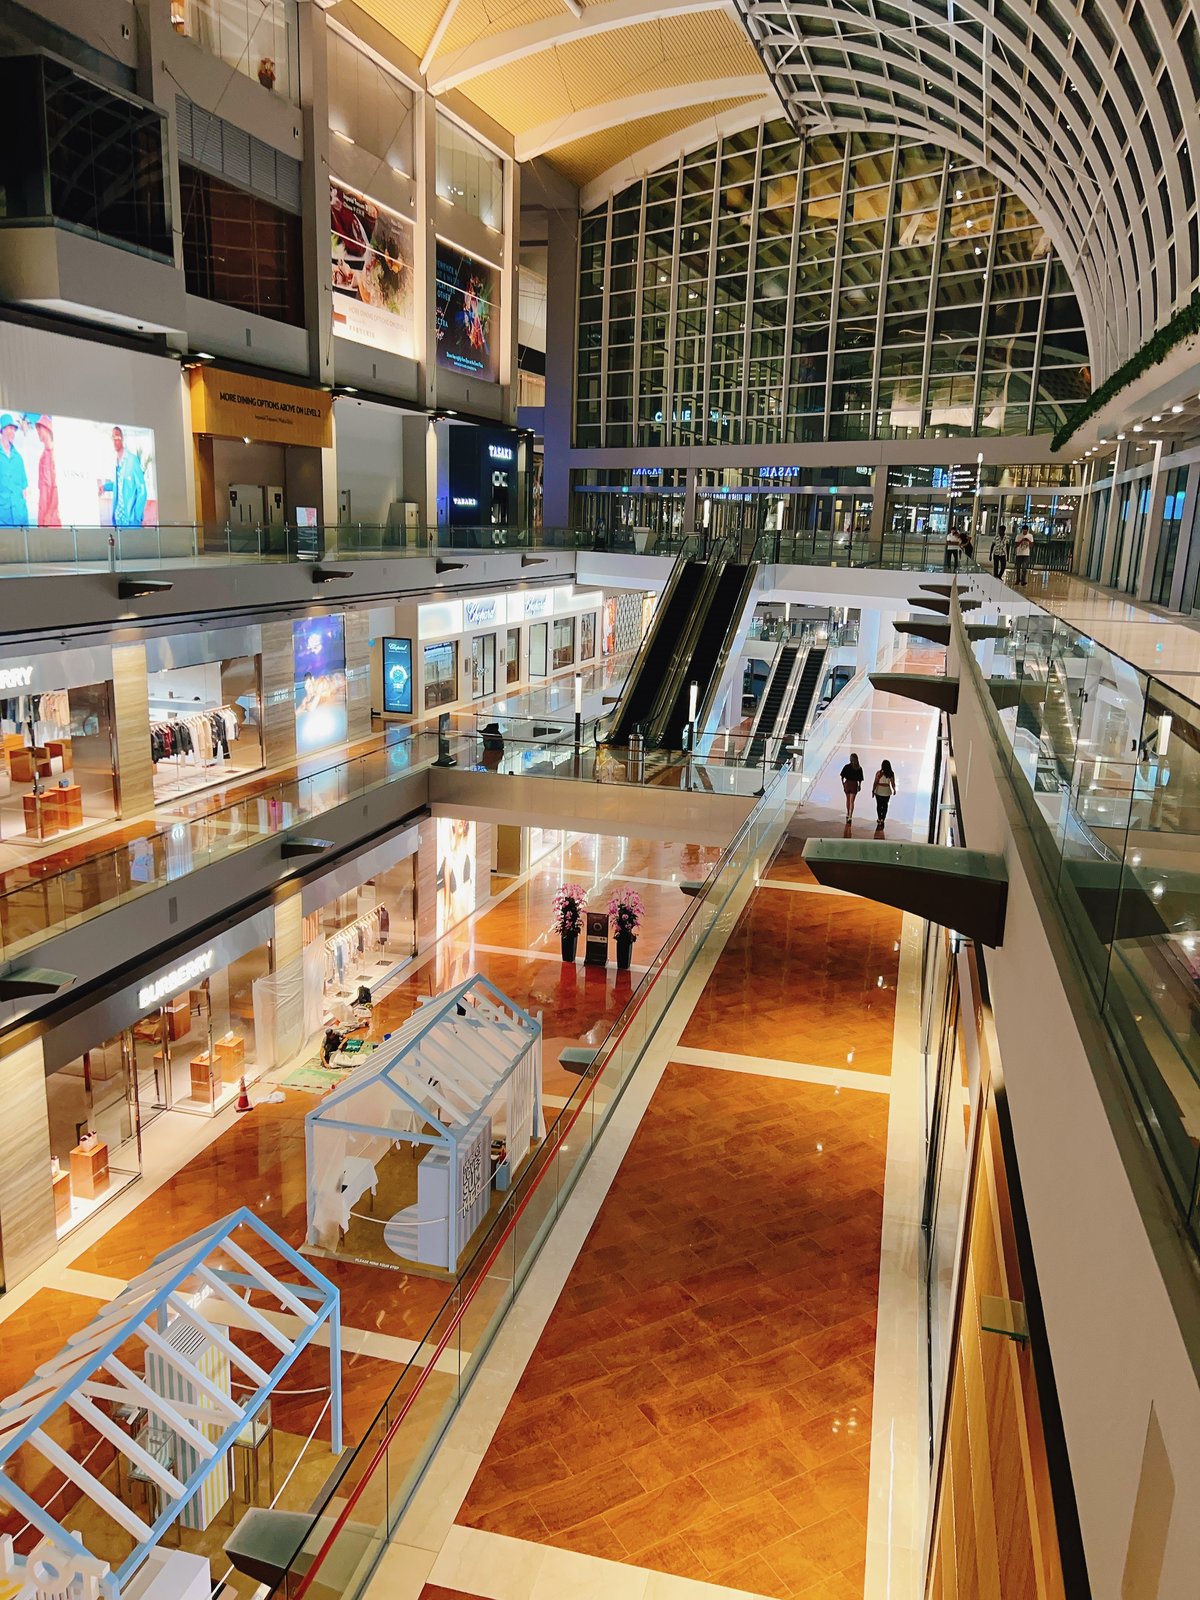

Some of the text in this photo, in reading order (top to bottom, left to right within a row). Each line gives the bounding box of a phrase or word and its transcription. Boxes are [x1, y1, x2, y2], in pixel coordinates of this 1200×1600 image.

[220, 392, 236, 403] MORE
[237, 395, 256, 406] DINING
[256, 399, 279, 410] OPTIONS
[280, 403, 296, 413] ABOVE
[296, 406, 304, 415] ON
[304, 408, 317, 417] LEVEL
[488, 445, 513, 460] TASAKI
[453, 497, 476, 506] TASAKI
[138, 949, 214, 1009] BURBERRY
